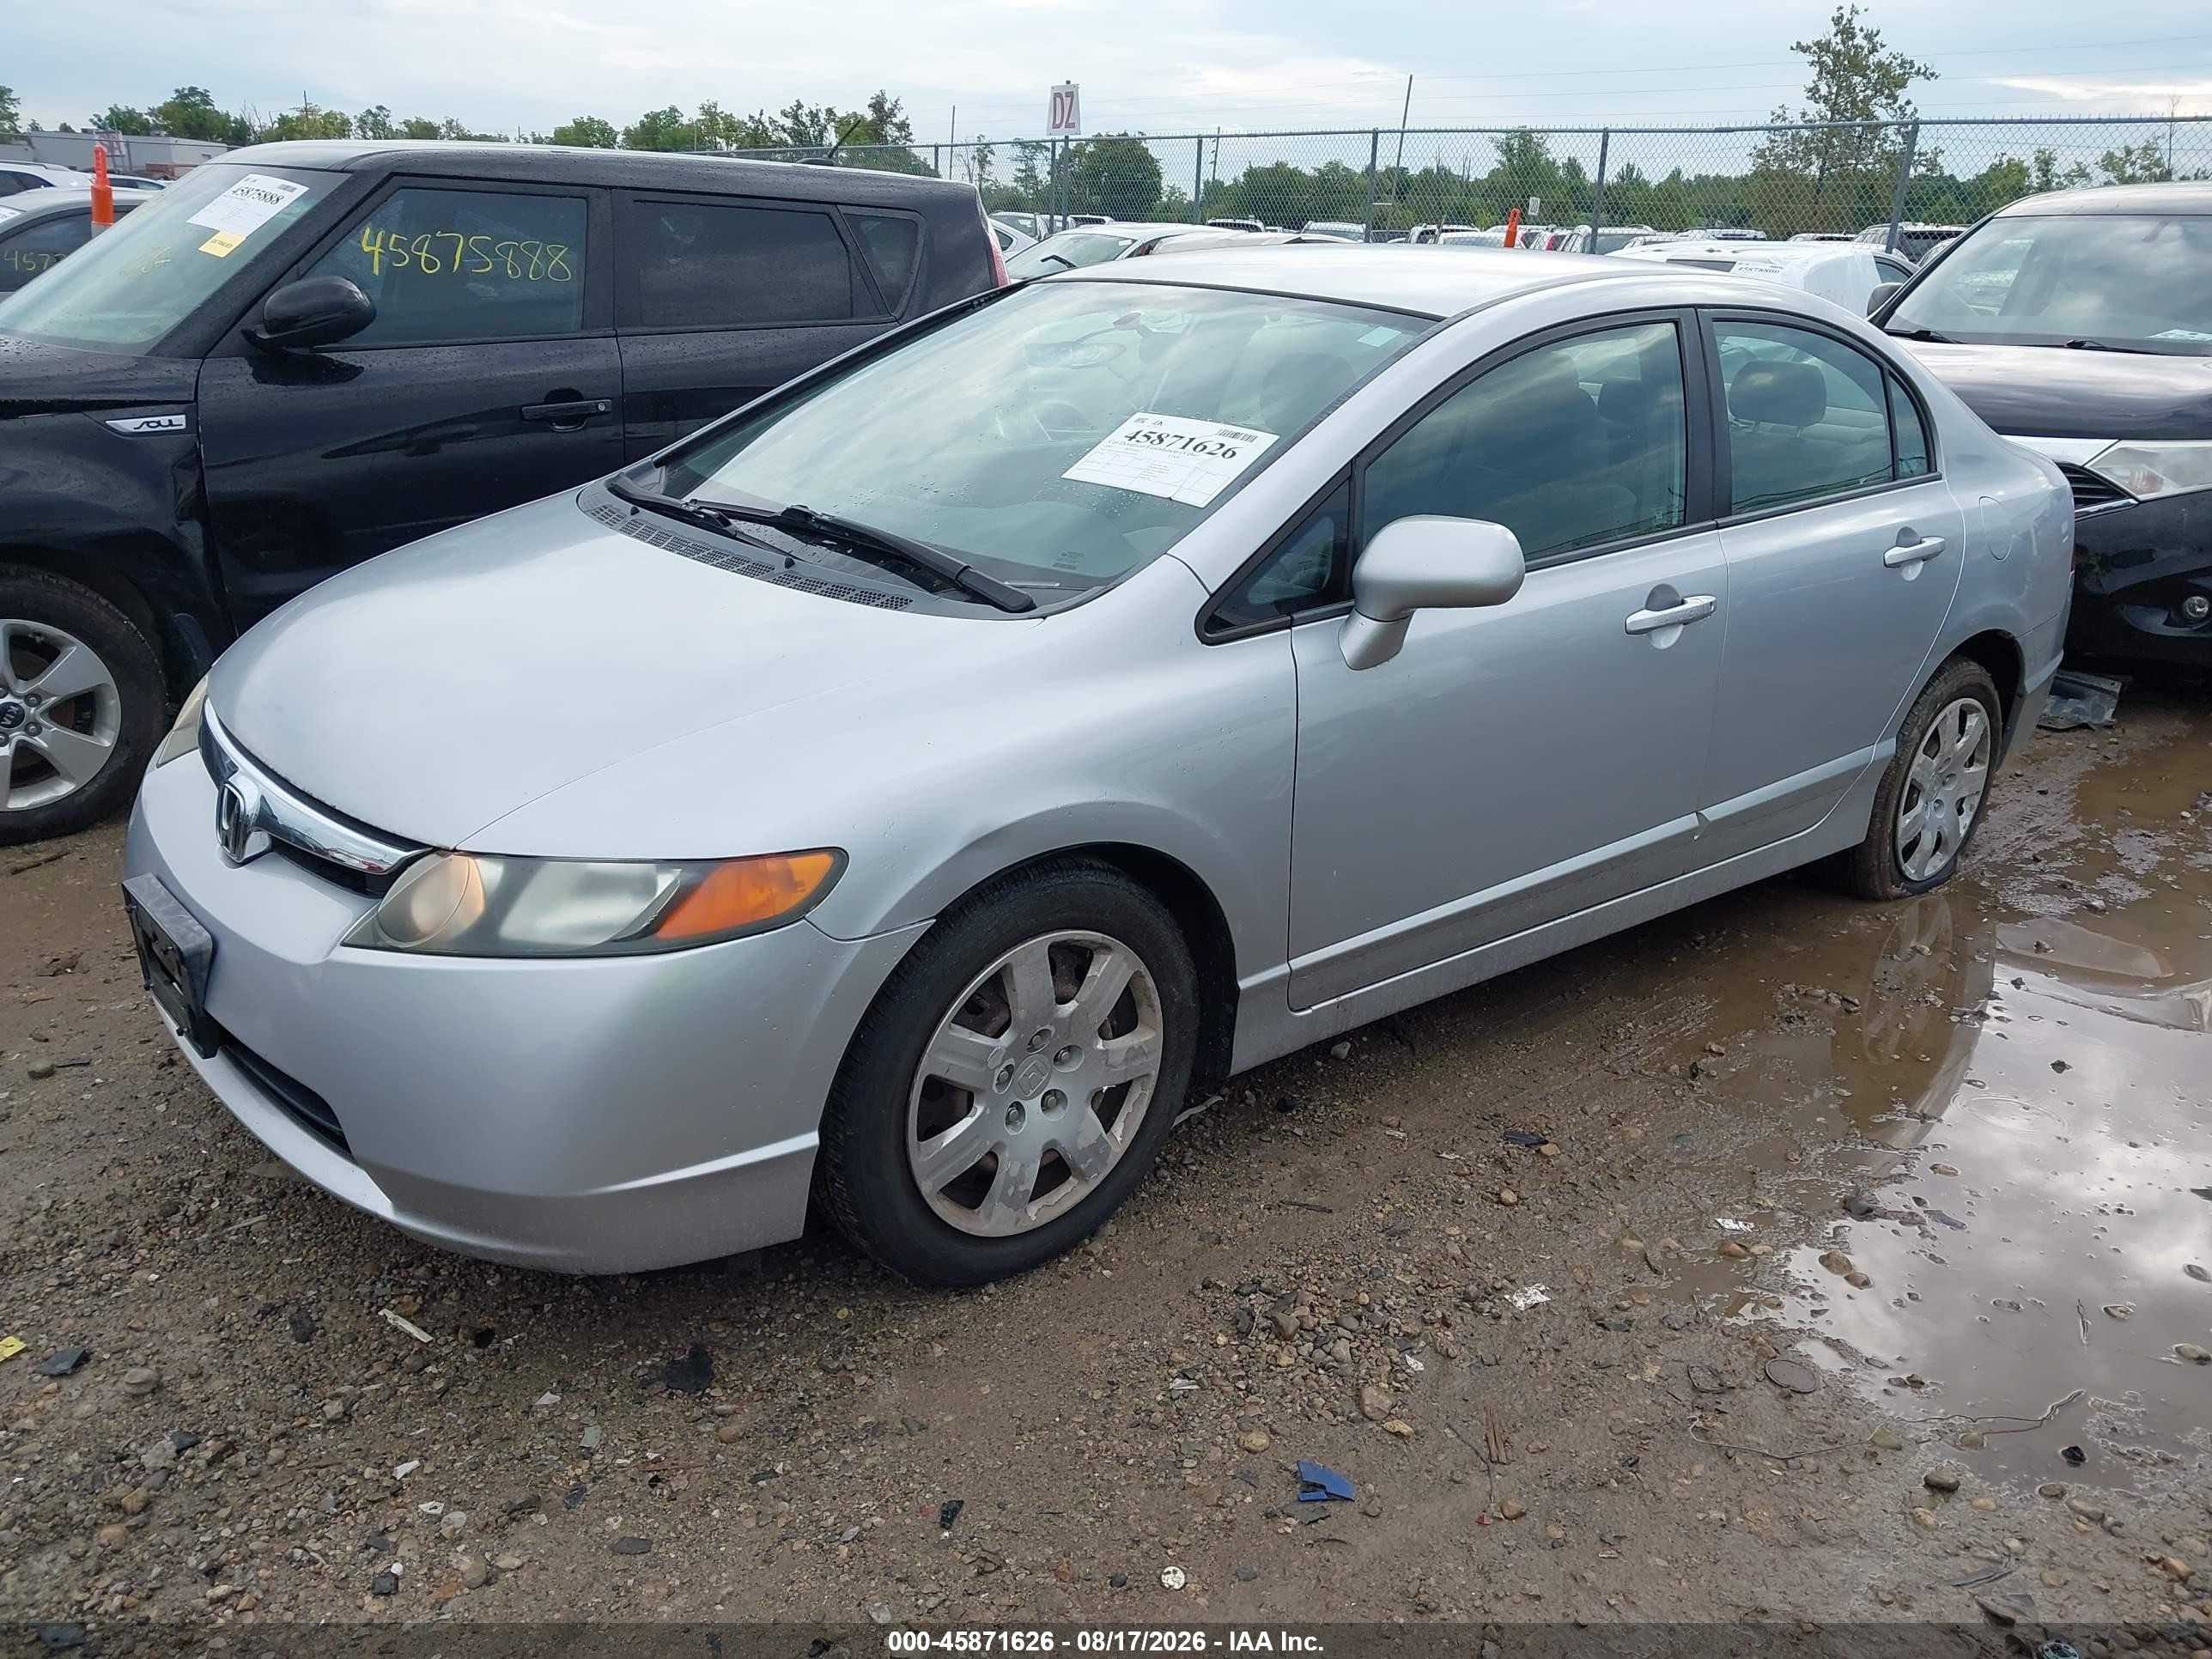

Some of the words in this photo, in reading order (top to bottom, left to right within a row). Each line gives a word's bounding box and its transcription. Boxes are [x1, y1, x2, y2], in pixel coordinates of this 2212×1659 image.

[232, 186, 285, 205] 45875888
[360, 223, 572, 282] 45875888
[133, 419, 183, 430] SOUL
[1125, 428, 1244, 459] 45871626
